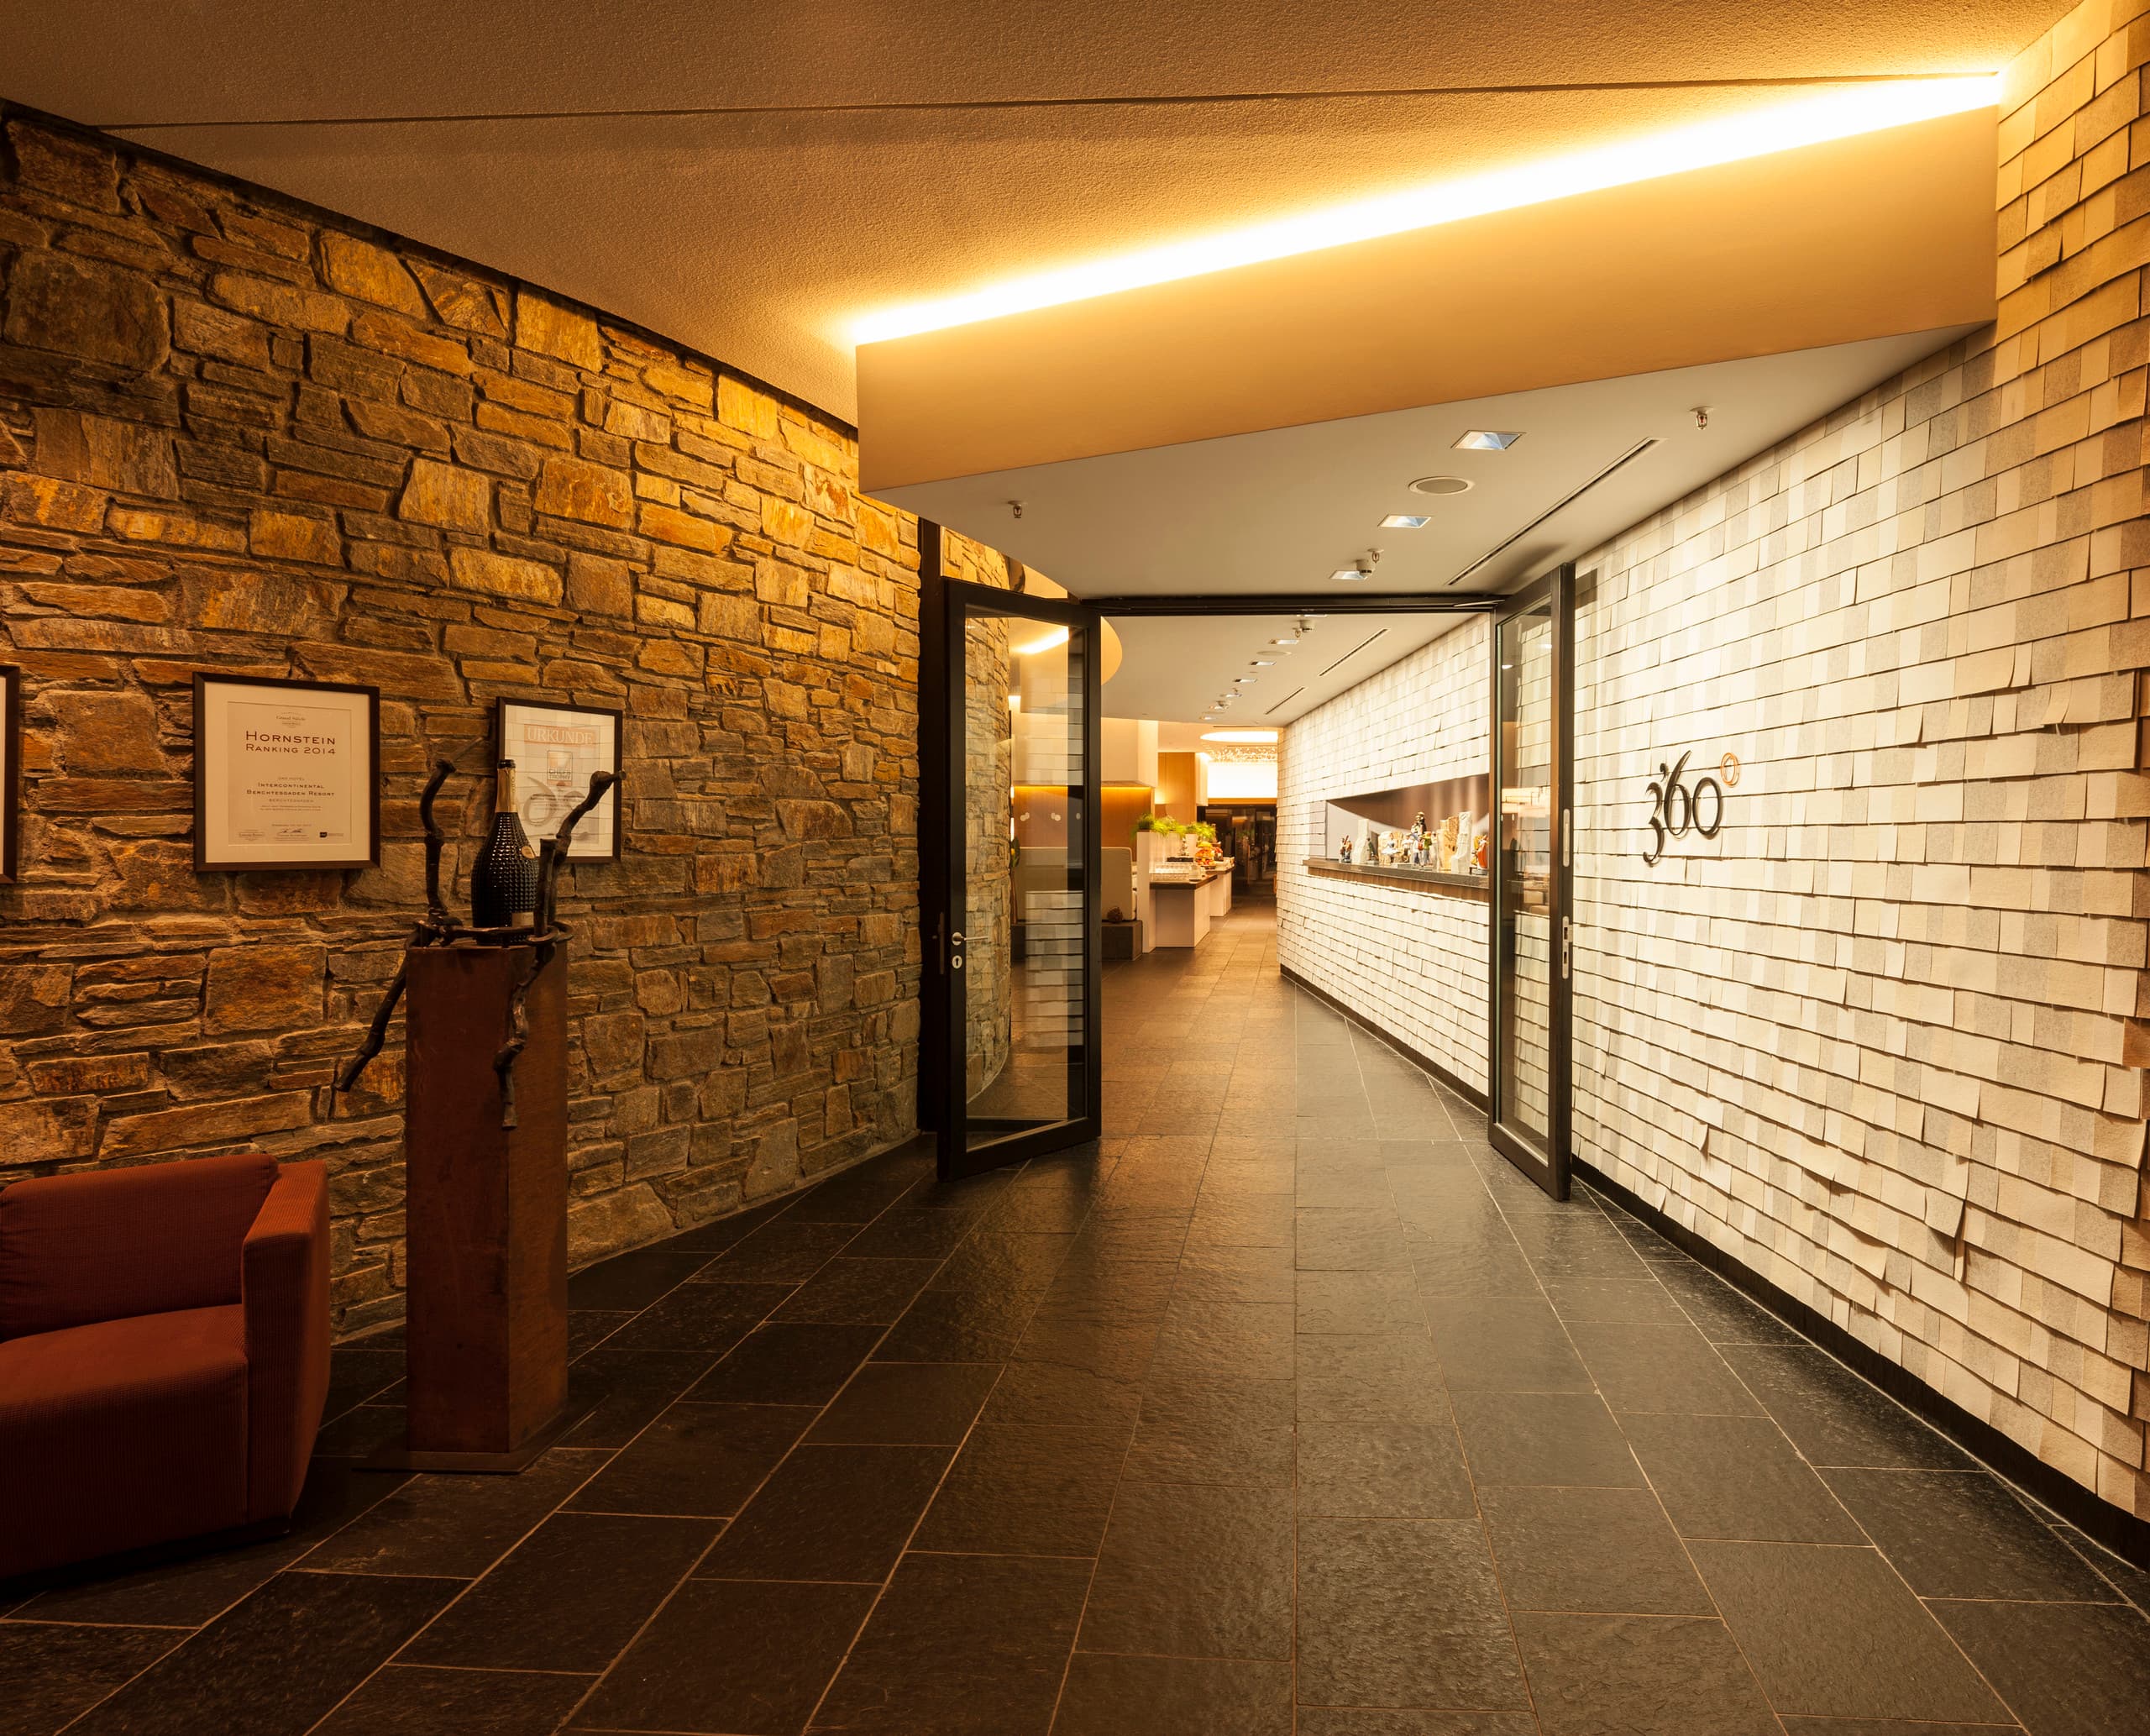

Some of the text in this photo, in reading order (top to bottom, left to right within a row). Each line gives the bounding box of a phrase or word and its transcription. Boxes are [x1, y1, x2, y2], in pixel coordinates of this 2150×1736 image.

[245, 730, 335, 745] HORNSTEIN
[527, 726, 593, 745] URKUNDE
[245, 743, 335, 755] RANKING 2014
